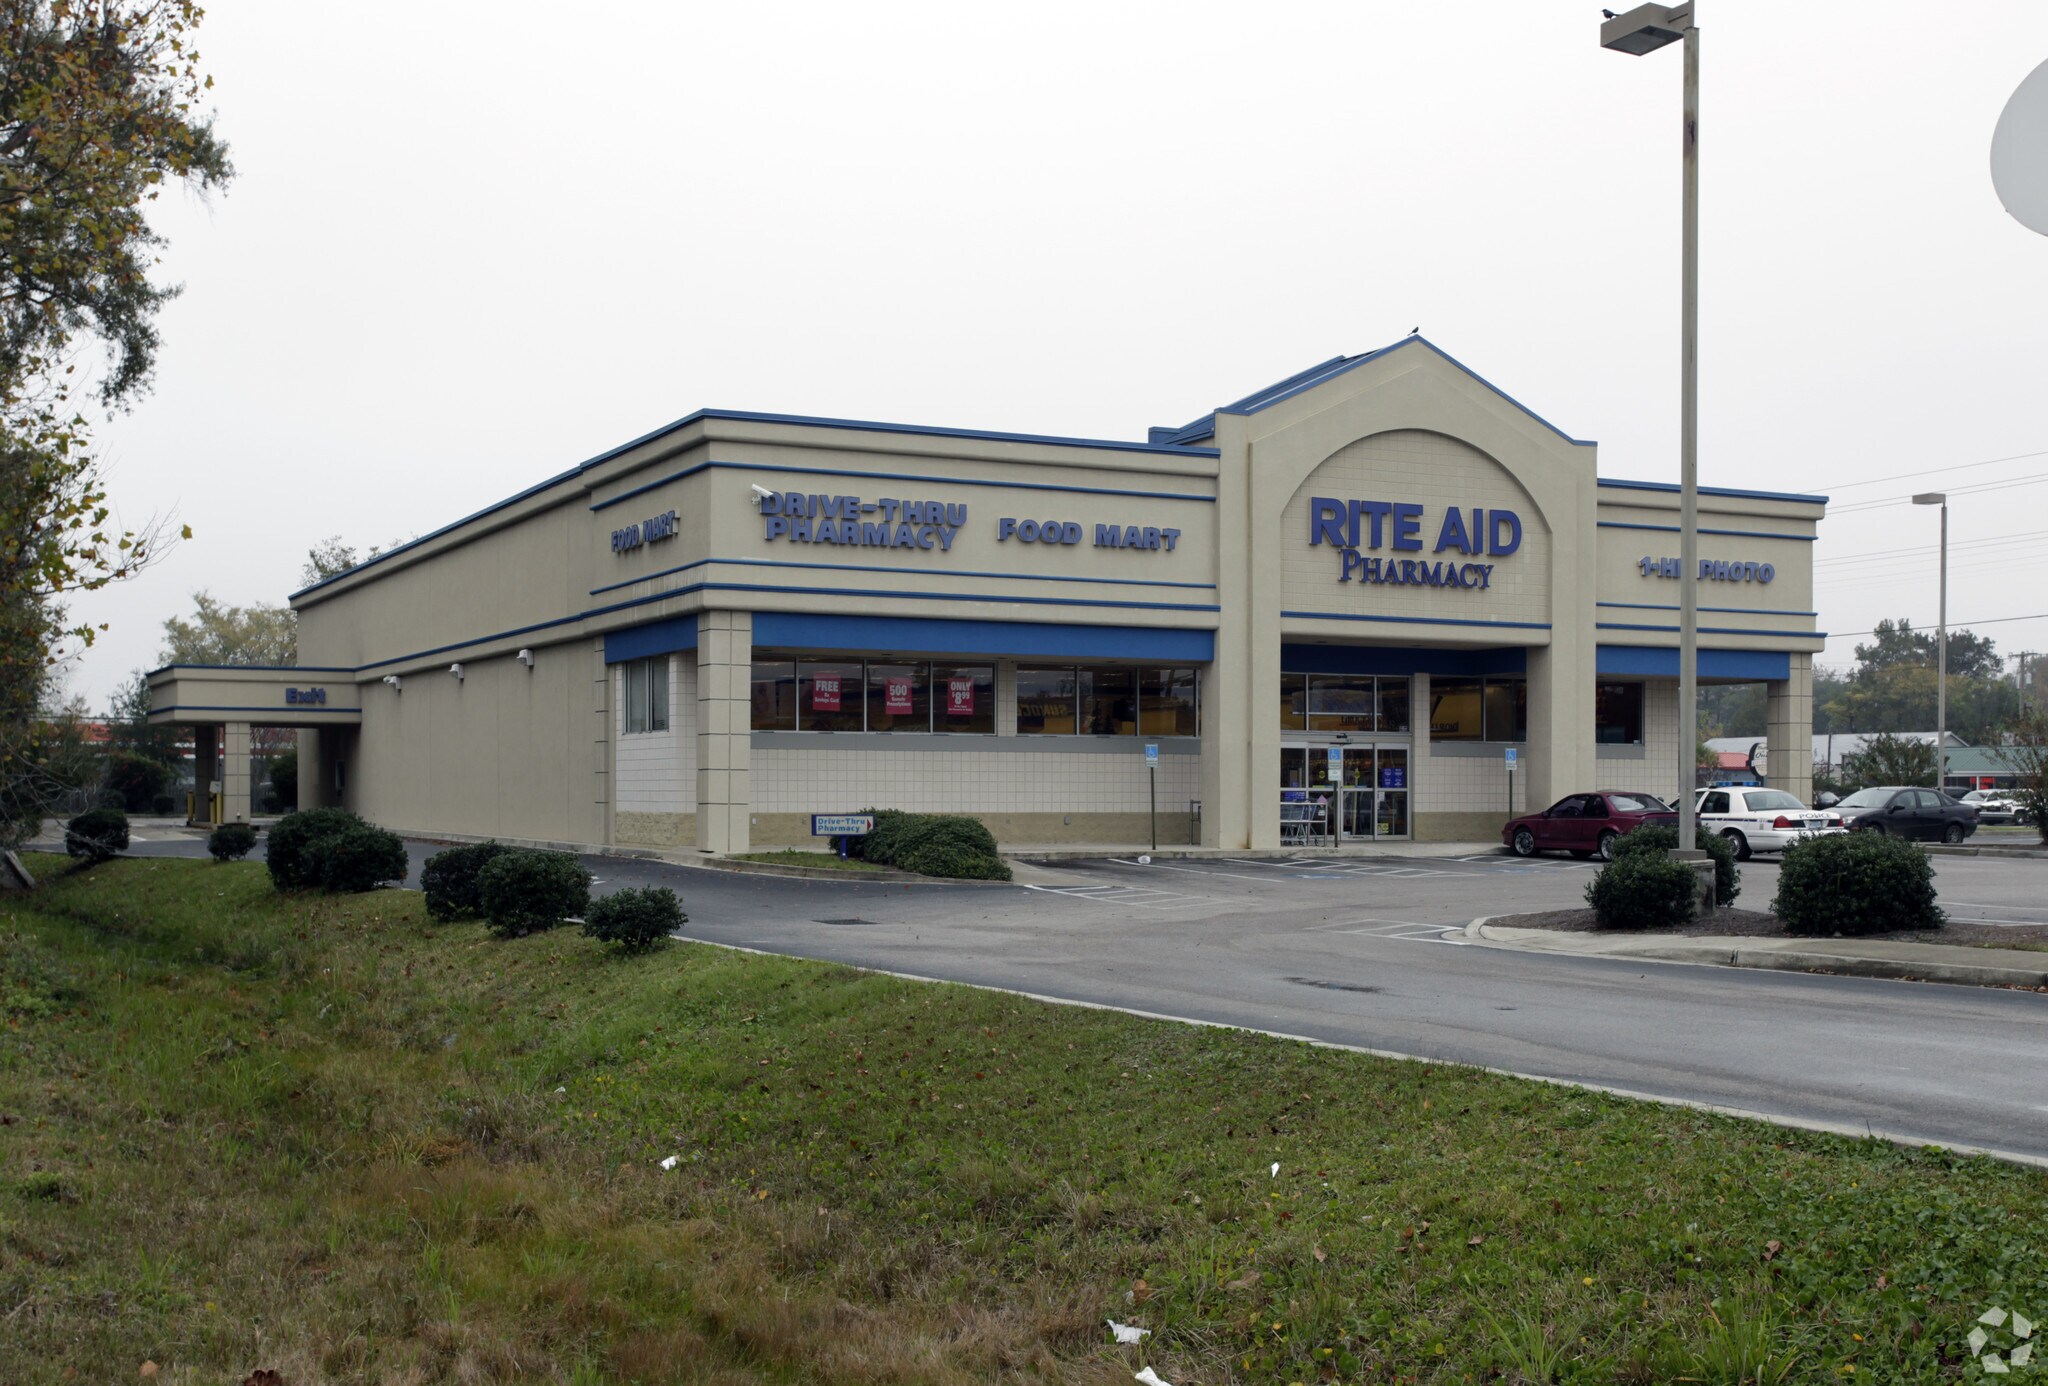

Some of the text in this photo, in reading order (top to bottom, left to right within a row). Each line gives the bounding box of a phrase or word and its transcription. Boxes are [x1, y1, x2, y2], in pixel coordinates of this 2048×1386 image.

[760, 491, 967, 527] DRIVE-THRU
[611, 510, 677, 552] FOOD MART
[765, 516, 959, 551] PHARMACY
[998, 518, 1181, 550] FOOD MART
[1309, 496, 1522, 557] RITE AID
[1338, 548, 1494, 589] PHARMACY
[1696, 559, 1775, 583] PHOTO
[285, 687, 326, 704] Exit
[815, 680, 839, 692] FREE
[889, 684, 907, 696] 500
[950, 681, 971, 691] ONLY
[818, 817, 865, 825] Drive-Thru
